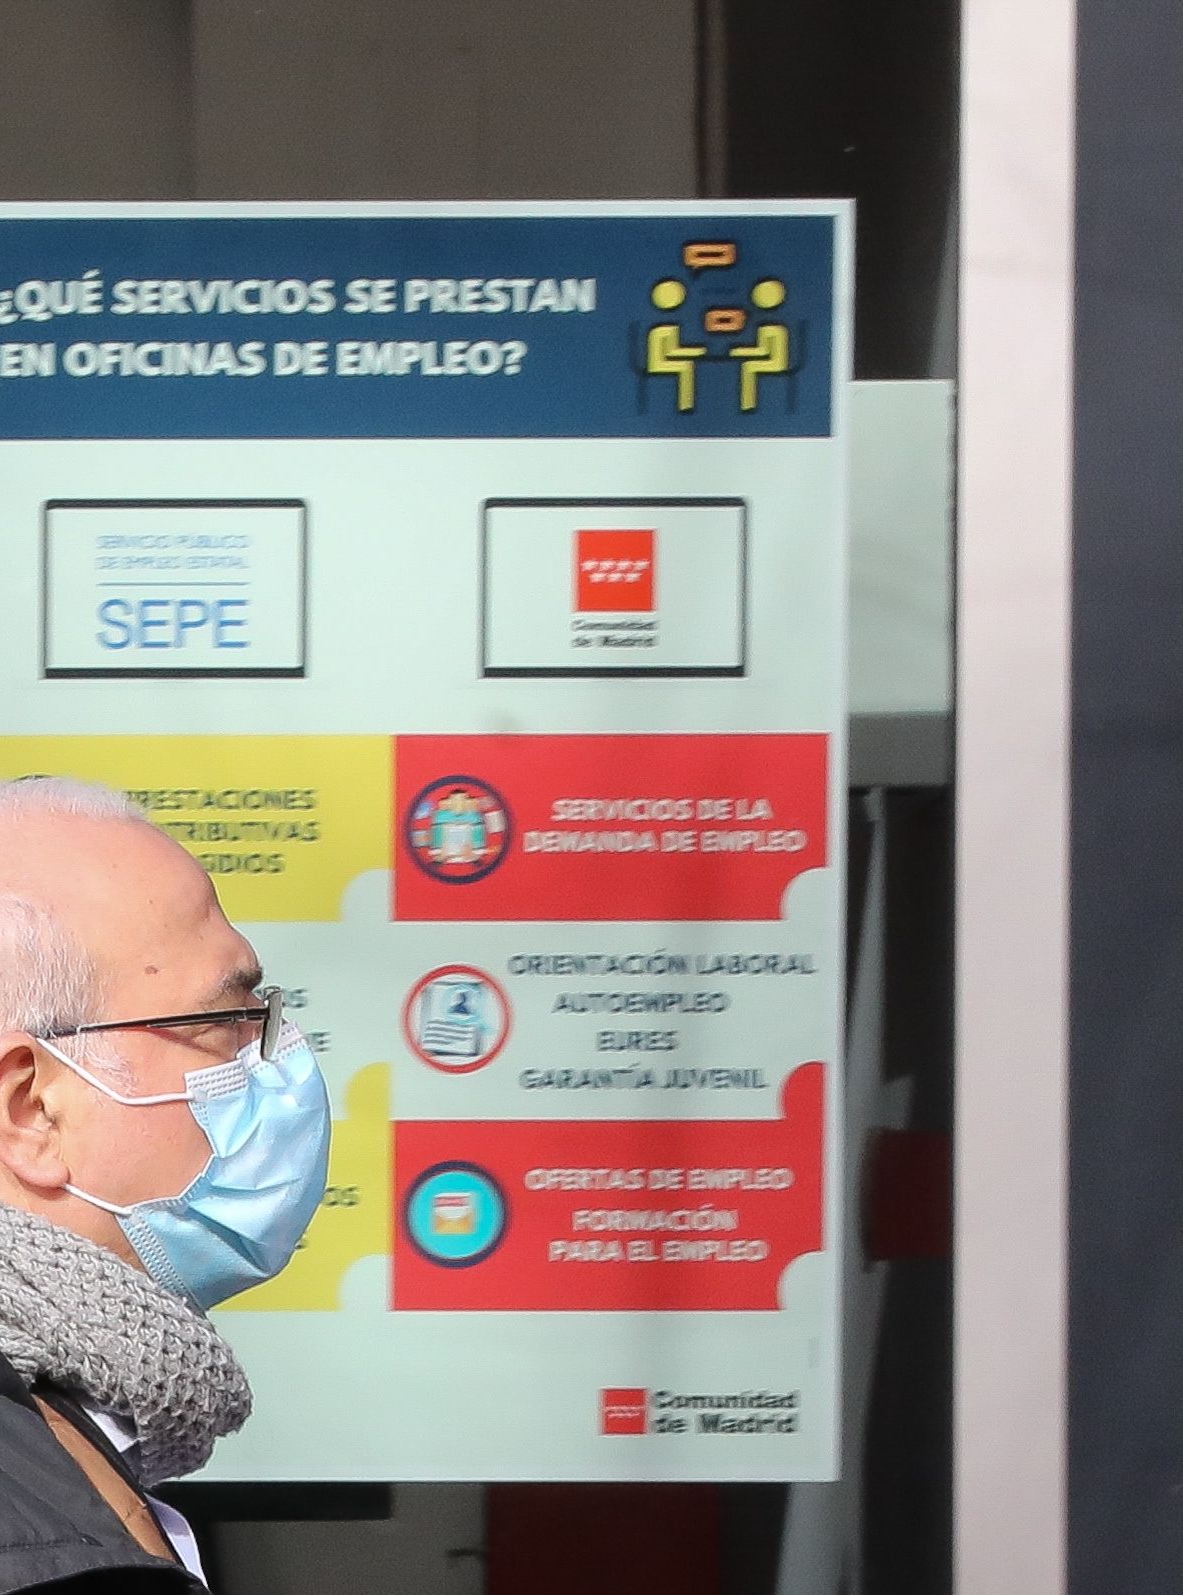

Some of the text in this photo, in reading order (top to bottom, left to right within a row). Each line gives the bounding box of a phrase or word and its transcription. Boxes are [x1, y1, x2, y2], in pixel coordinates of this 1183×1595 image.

[109, 279, 336, 314] SERVICIOS
[343, 279, 397, 314] SE
[404, 279, 597, 314] PRESTAN
[62, 341, 267, 377] OFICINAS
[273, 341, 328, 377] DE
[336, 341, 528, 377] EMPLEO?
[95, 599, 251, 650] SEPE
[551, 798, 774, 821] SERVICIOS DE LA
[523, 829, 808, 852] DEMANDA DE EMPLEO
[508, 947, 818, 975] ORIENTACIÓN LABORAL
[551, 992, 732, 1014] AUTOEMPLEO
[596, 1030, 680, 1051] EURES
[519, 1063, 770, 1089] GARANTÍA JUVENIL
[524, 1168, 795, 1190] OFERTAS DE EMPLEO
[572, 1203, 739, 1231] FORMACIÓN
[548, 1239, 770, 1262] PARA EL EMPLEO
[653, 1389, 801, 1409] Comunidad
[653, 1414, 801, 1434] de Madrid
